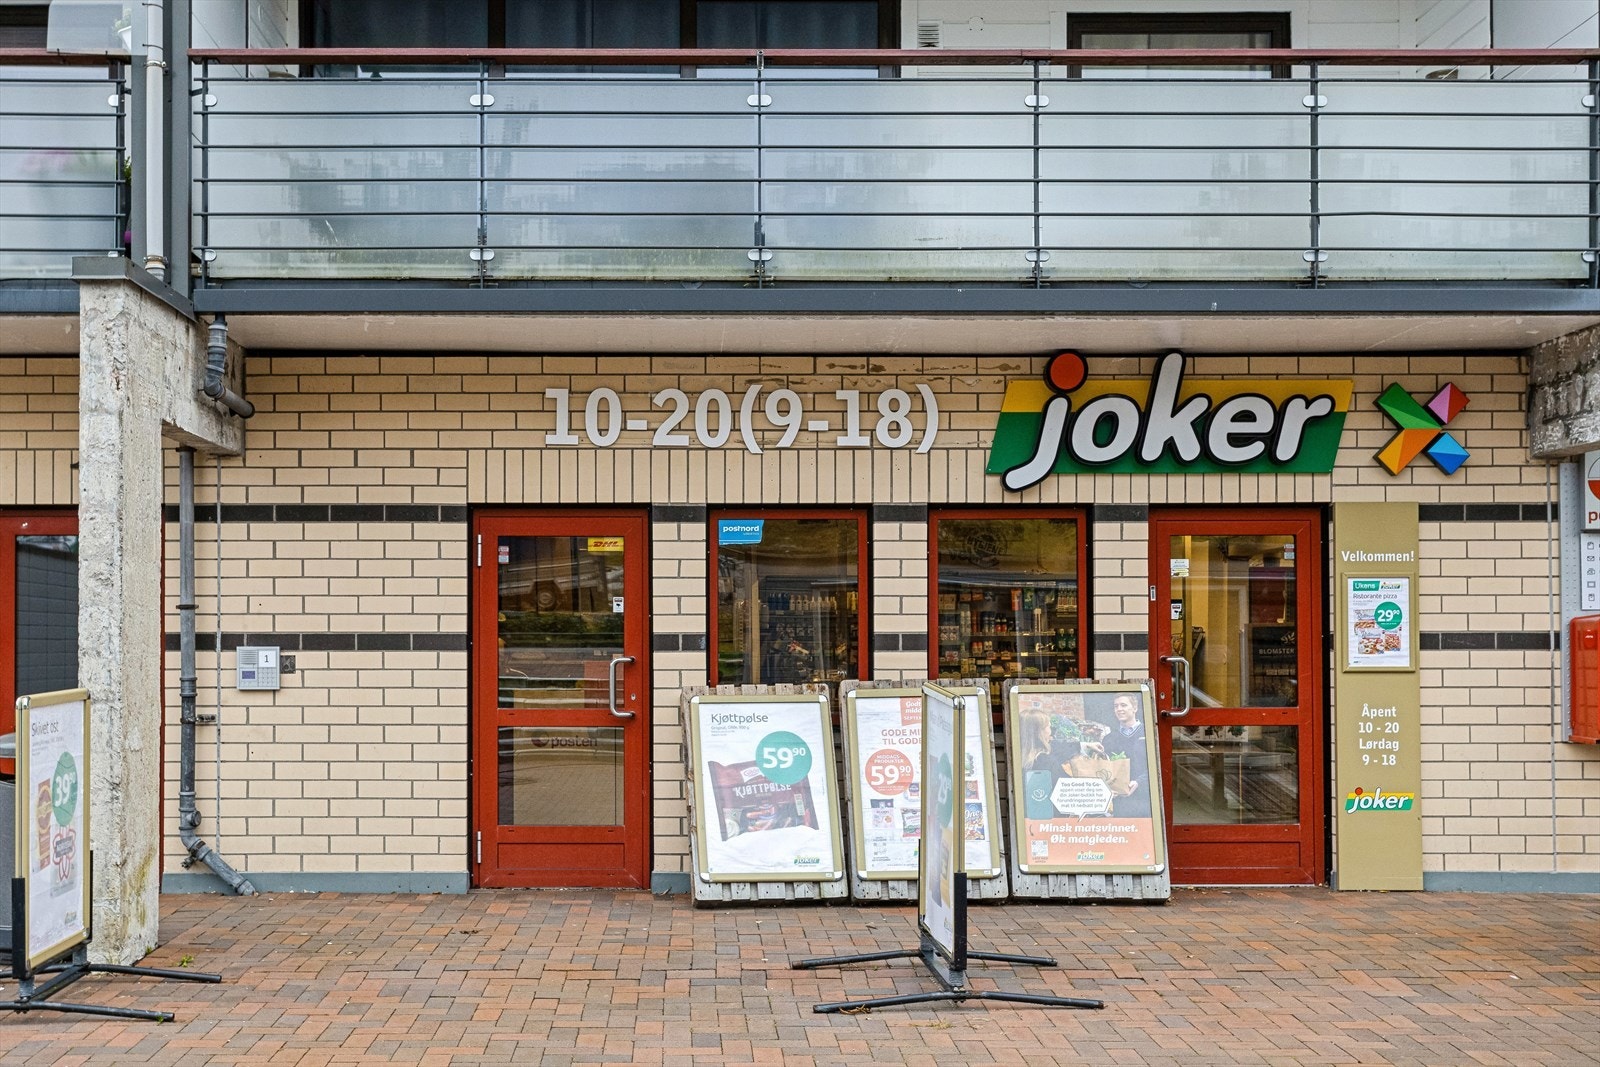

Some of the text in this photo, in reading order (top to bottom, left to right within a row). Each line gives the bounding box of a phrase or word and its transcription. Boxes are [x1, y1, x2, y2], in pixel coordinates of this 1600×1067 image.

[544, 383, 939, 454] 10-20(9-18)
[1002, 350, 1336, 491] joker
[722, 525, 760, 533] postnord
[1341, 550, 1415, 562] Velkommen!
[264, 654, 269, 663] 1
[1361, 703, 1397, 719] Åpent
[711, 712, 769, 725] Kjøttpølse
[881, 729, 907, 737] GODE
[1358, 722, 1373, 733] 10
[1384, 722, 1400, 733] 20
[551, 735, 598, 749] posten
[1359, 738, 1399, 752] Lørdag
[1362, 754, 1370, 766] 9
[1381, 754, 1397, 766] 18
[1347, 786, 1409, 814] joker
[1039, 822, 1139, 833] Minsk matsvinnet.
[1050, 834, 1129, 846] Øk matgleden.
